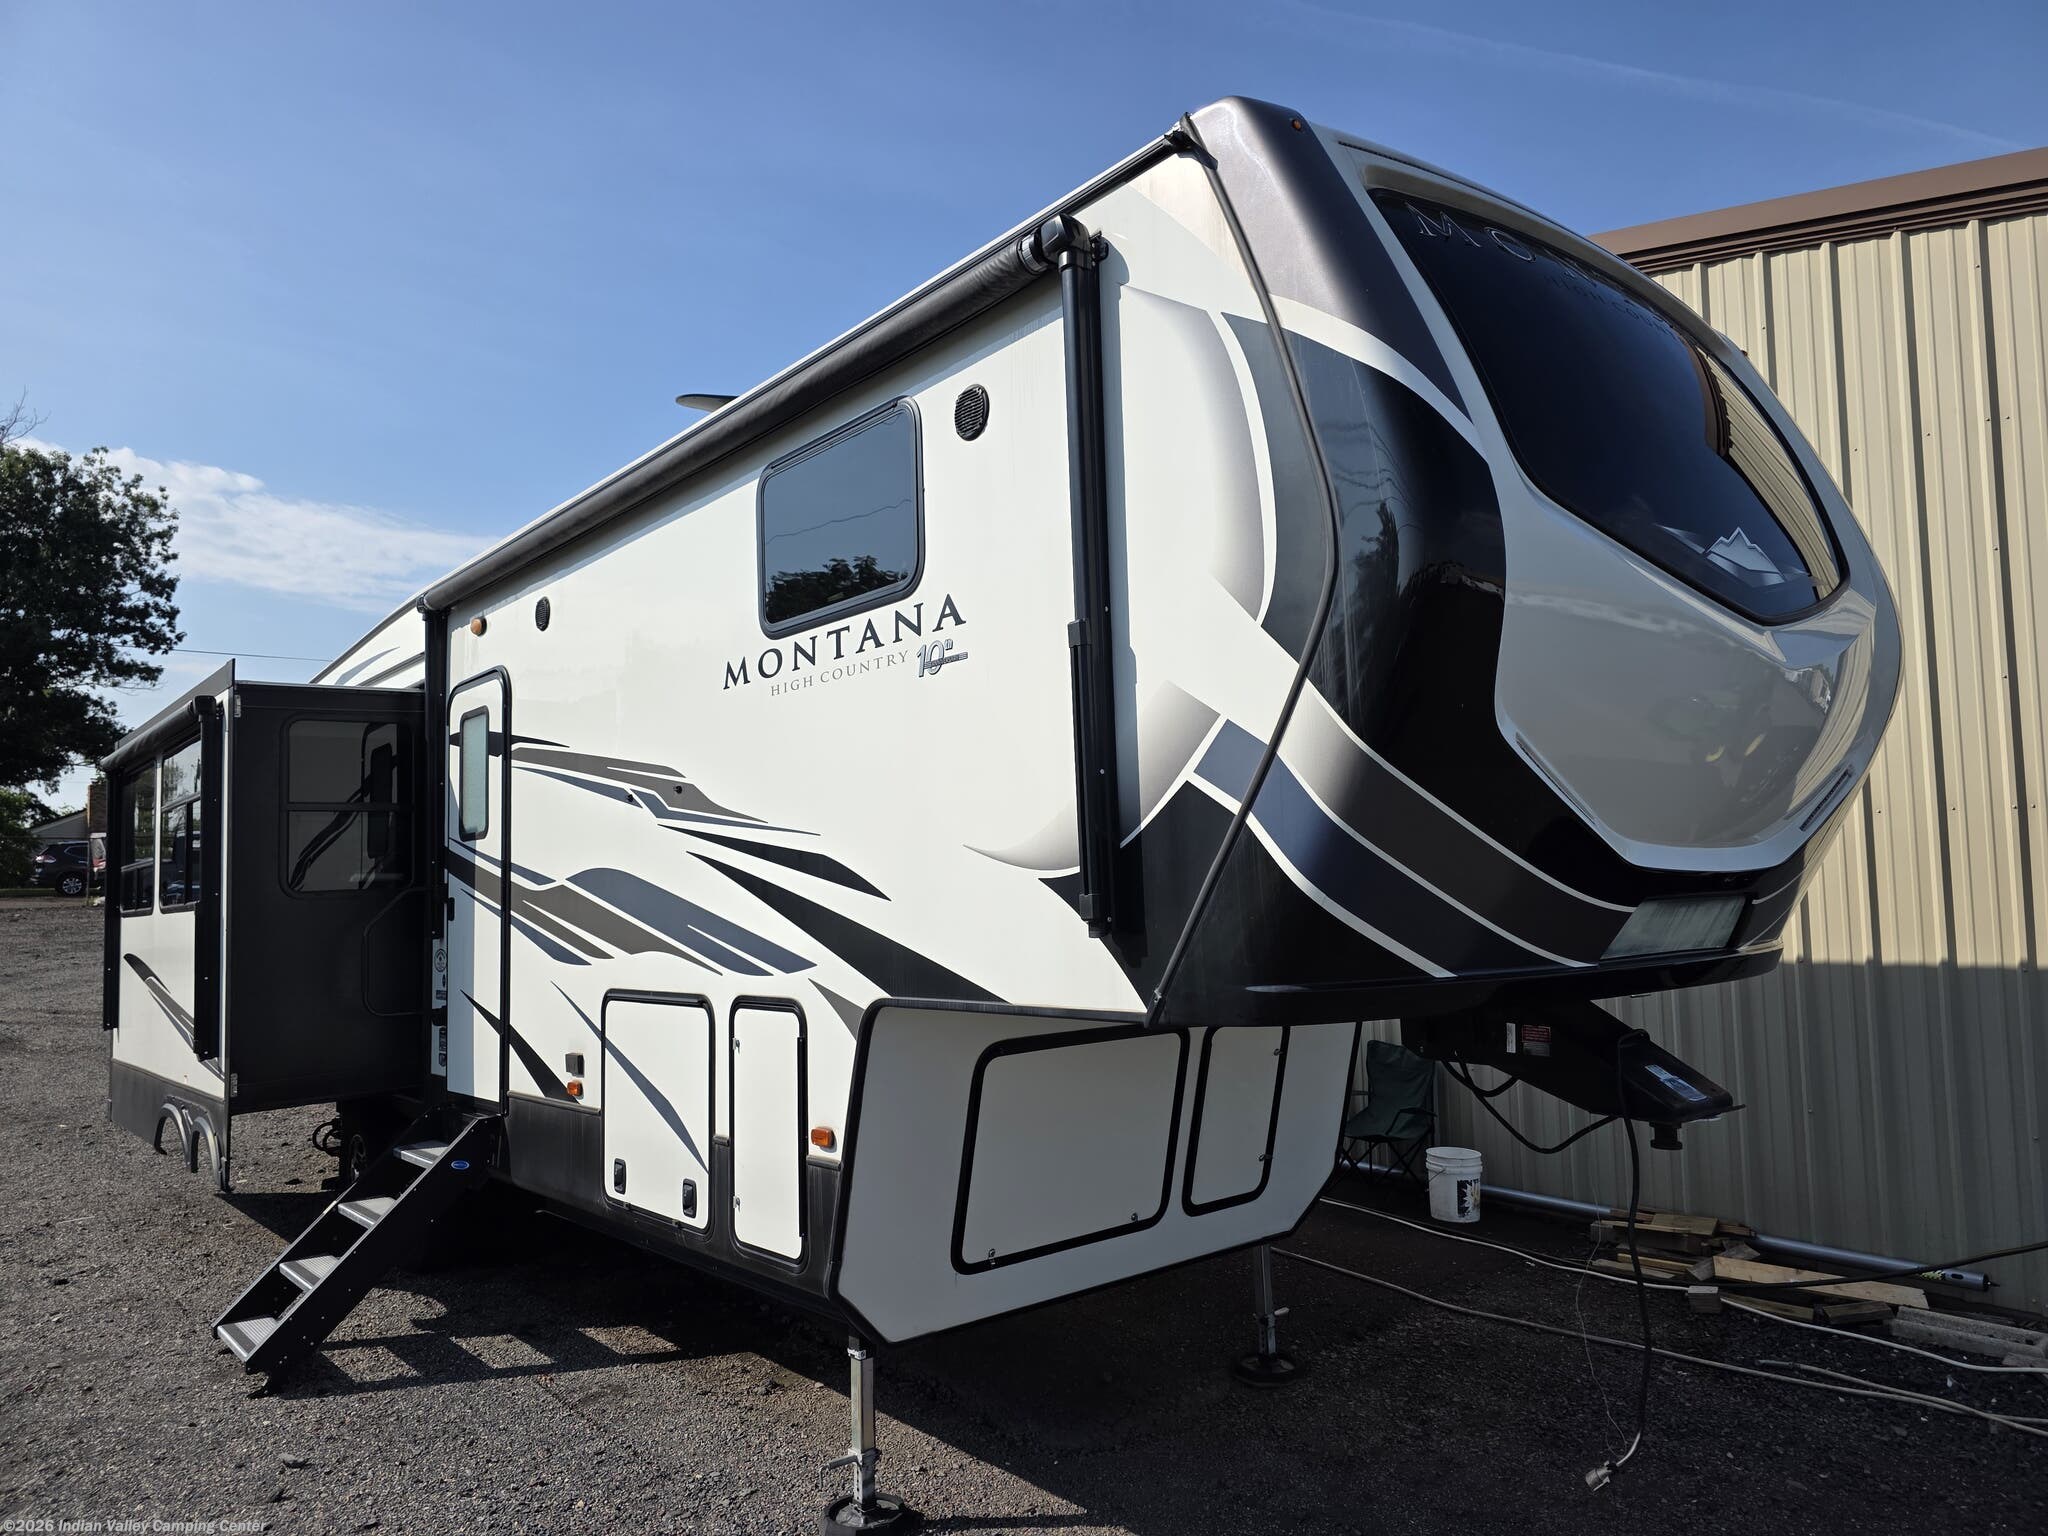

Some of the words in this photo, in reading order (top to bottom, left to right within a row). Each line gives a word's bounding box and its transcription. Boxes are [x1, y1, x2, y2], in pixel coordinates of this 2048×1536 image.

[723, 594, 967, 690] MONTANA
[771, 675, 813, 697] HIGH
[820, 650, 909, 683] COUNTRY
